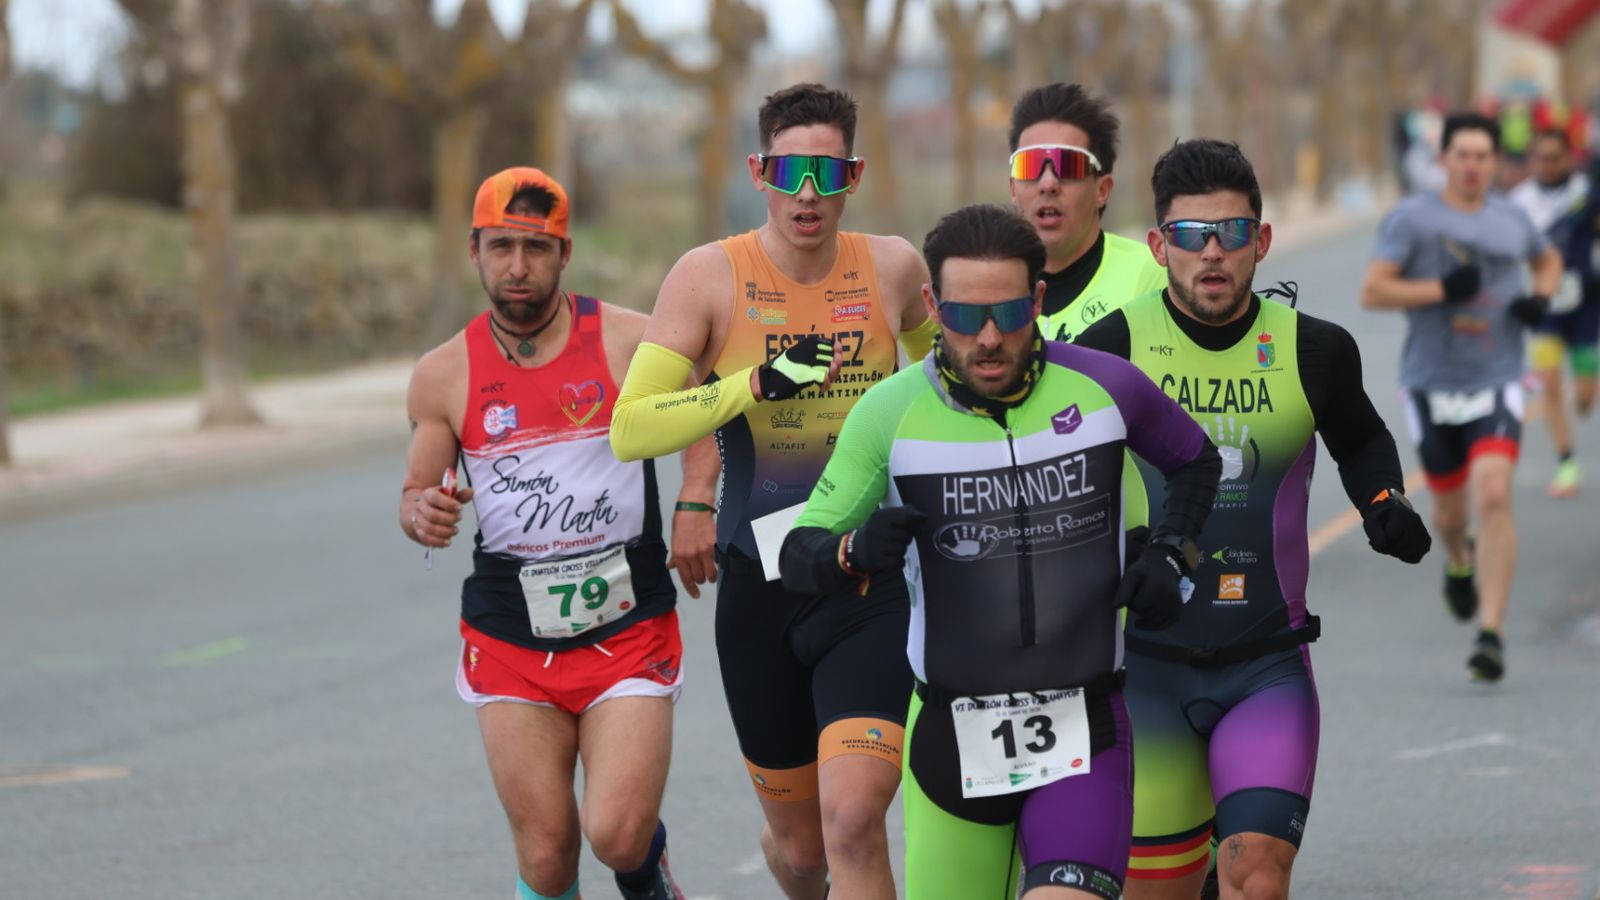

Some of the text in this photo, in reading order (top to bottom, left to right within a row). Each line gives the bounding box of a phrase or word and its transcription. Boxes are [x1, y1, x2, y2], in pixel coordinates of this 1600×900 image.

[655, 394, 698, 411] Diputación
[1160, 373, 1274, 414] CALZADA
[769, 442, 806, 450] ALTAFIT
[491, 455, 559, 494] Simón
[1217, 482, 1248, 491] ORTIVO
[515, 489, 619, 534] Martín
[982, 524, 1054, 543] Roberto
[1056, 510, 1105, 540] Ramos
[552, 533, 605, 550] Premium
[561, 562, 583, 573] CROSS
[547, 576, 609, 618] 79
[967, 699, 1000, 712] DUTLÓN
[1003, 697, 1029, 708] COSS
[1032, 689, 1080, 705] VIAMAYOR
[991, 714, 1057, 759] 13
